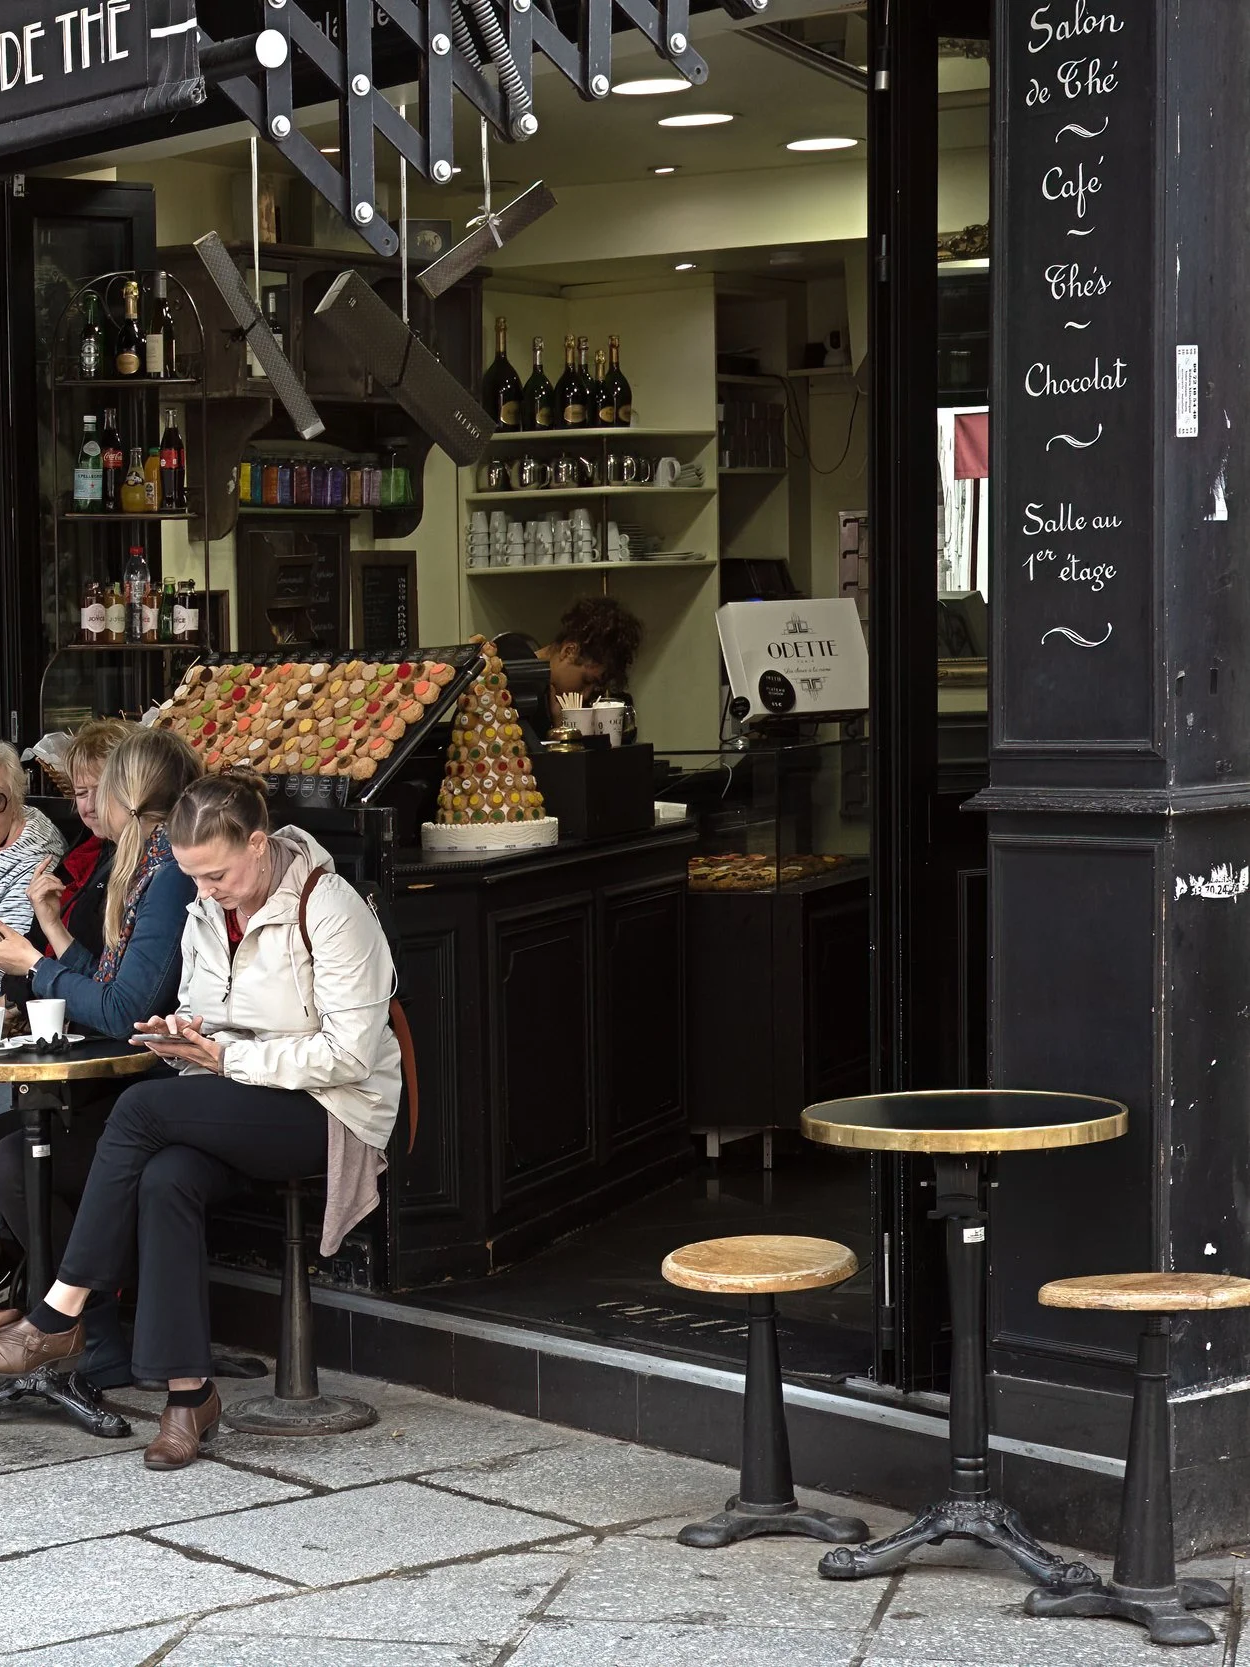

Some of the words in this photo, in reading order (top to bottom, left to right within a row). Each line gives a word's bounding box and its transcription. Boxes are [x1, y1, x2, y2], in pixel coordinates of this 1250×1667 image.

[1027, 0, 1124, 53] Salon
[1025, 78, 1050, 106] de
[1056, 57, 1118, 98] Thé
[1041, 155, 1103, 218] Café
[1044, 262, 1111, 299] Thés
[1024, 356, 1127, 396] Chocolat
[1022, 502, 1087, 535] Salle
[1092, 515, 1122, 529] au
[1057, 553, 1116, 591] étage
[767, 640, 839, 660] ODETTE
